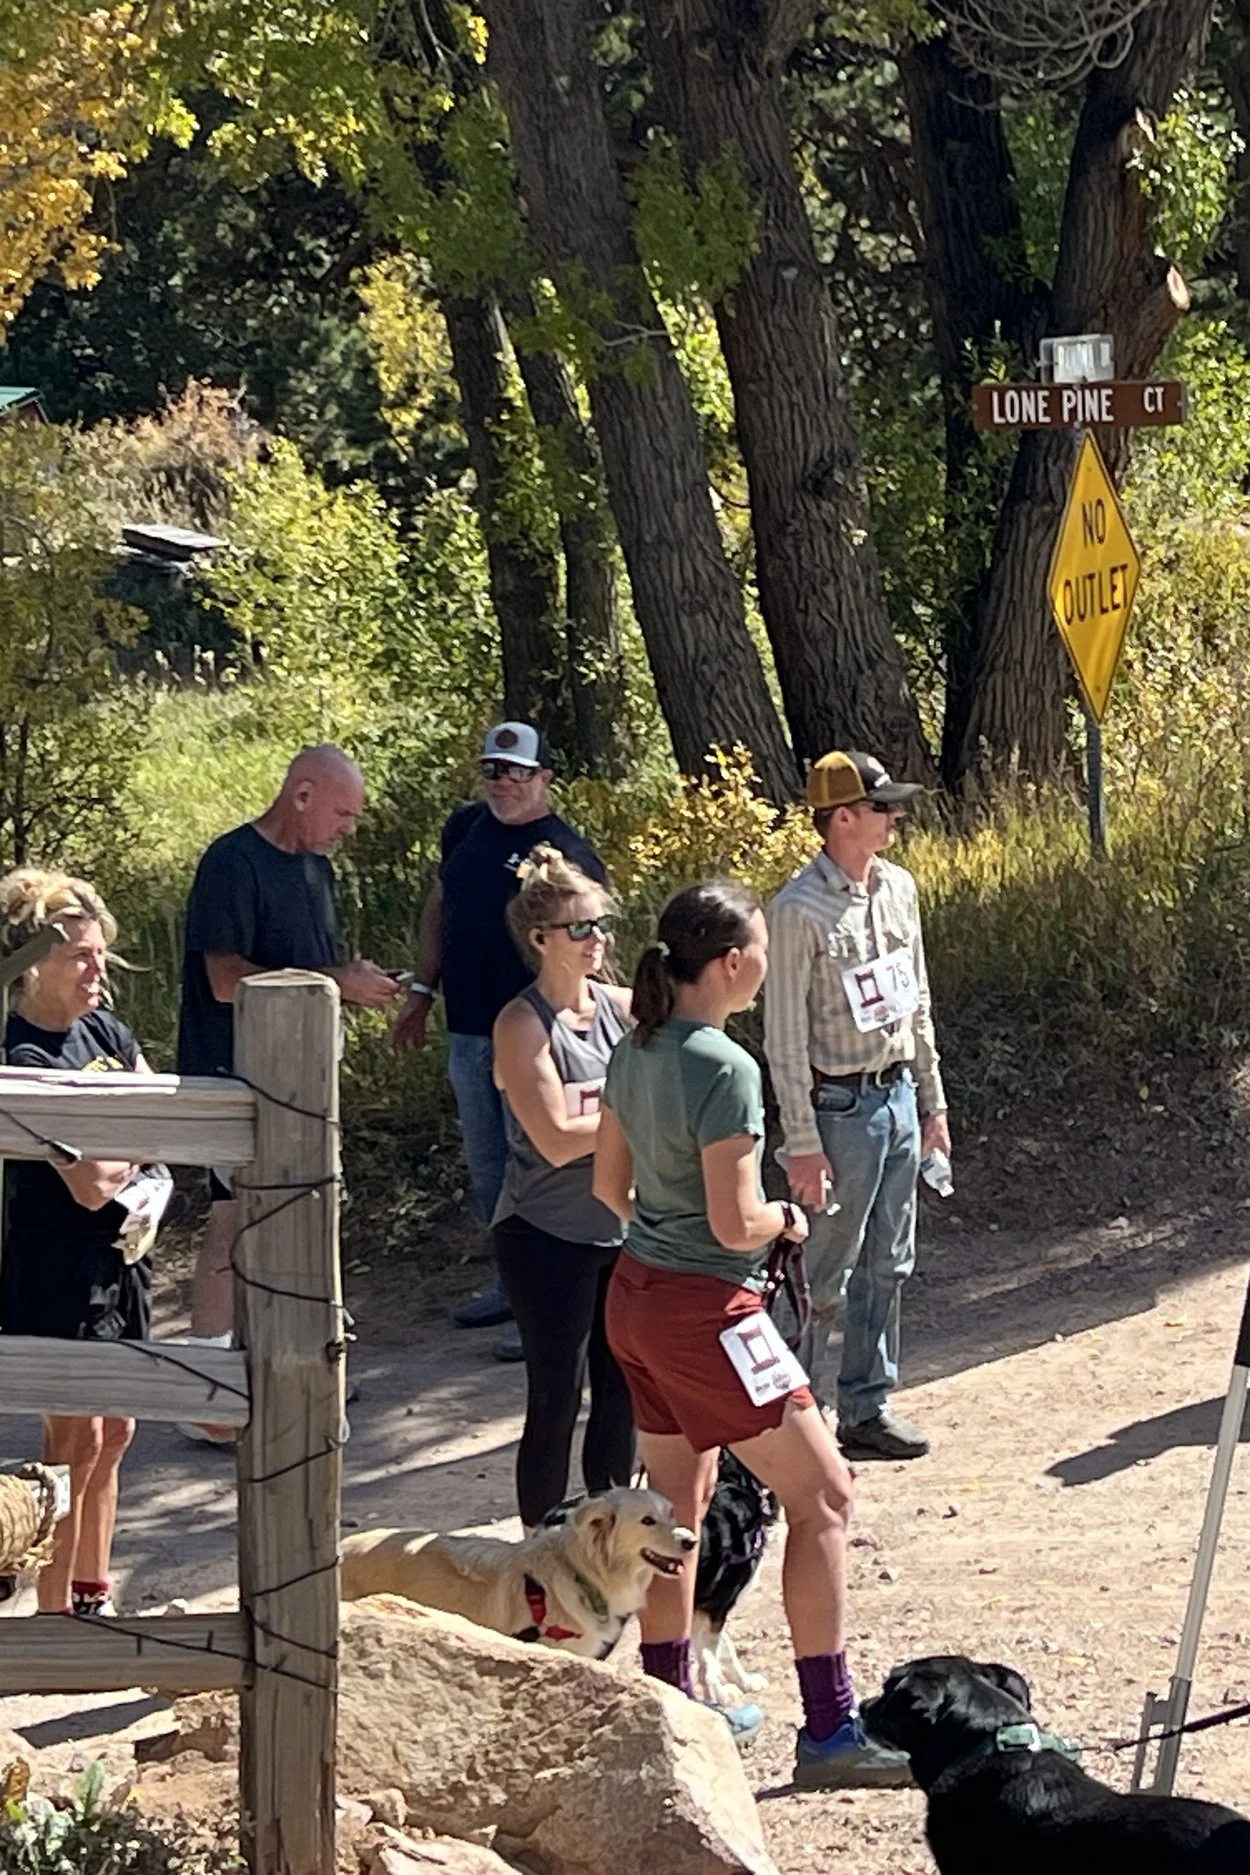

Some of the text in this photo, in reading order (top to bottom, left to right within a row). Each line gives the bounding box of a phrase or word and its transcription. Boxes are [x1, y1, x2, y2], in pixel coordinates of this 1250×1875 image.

[992, 386, 1164, 424] LONE PINE CT
[1081, 498, 1106, 549] NO
[1063, 563, 1128, 626] OUTLET
